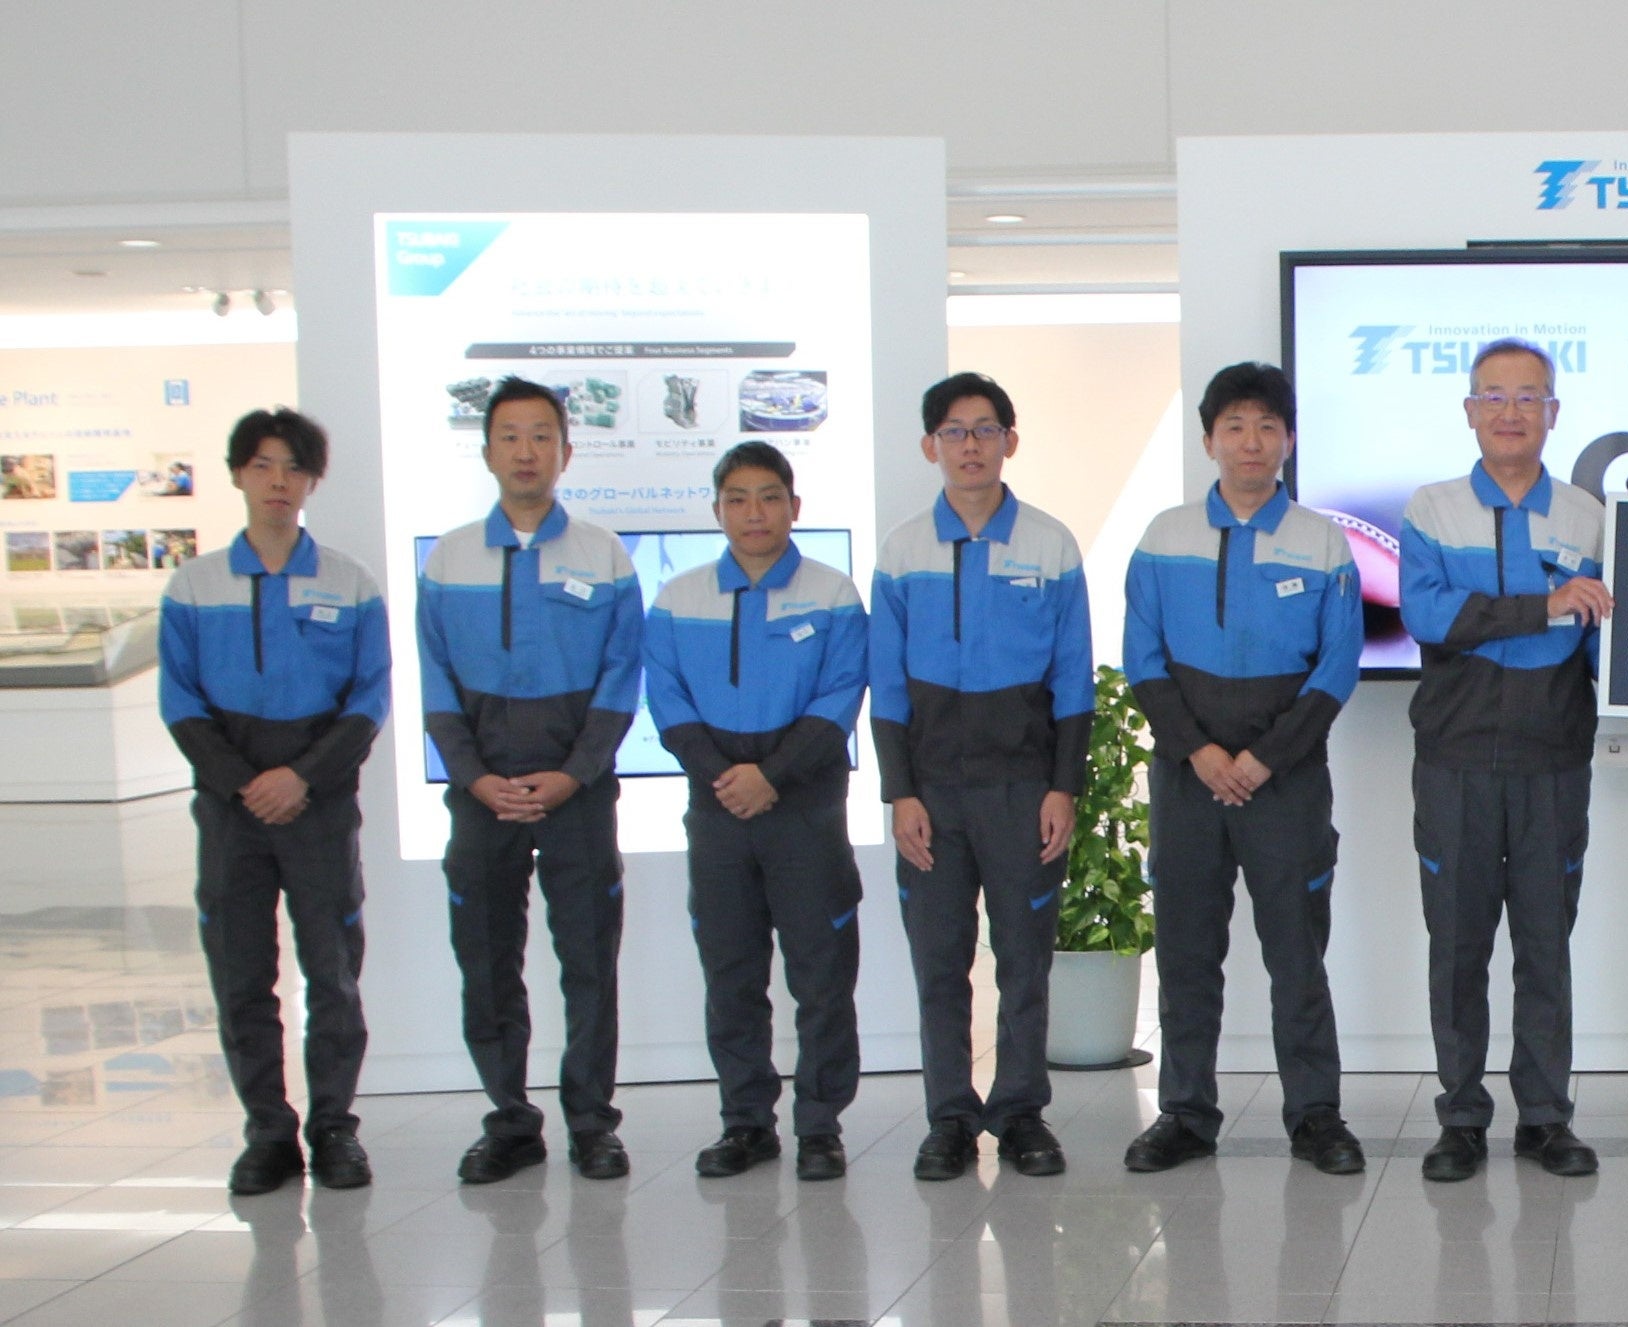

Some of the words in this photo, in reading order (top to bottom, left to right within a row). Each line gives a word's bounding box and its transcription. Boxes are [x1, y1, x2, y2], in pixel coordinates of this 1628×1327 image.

[1429, 323, 1509, 336] Innovation
[1515, 323, 1528, 335] in
[1533, 323, 1587, 335] Motion
[13, 391, 57, 406] Plant
